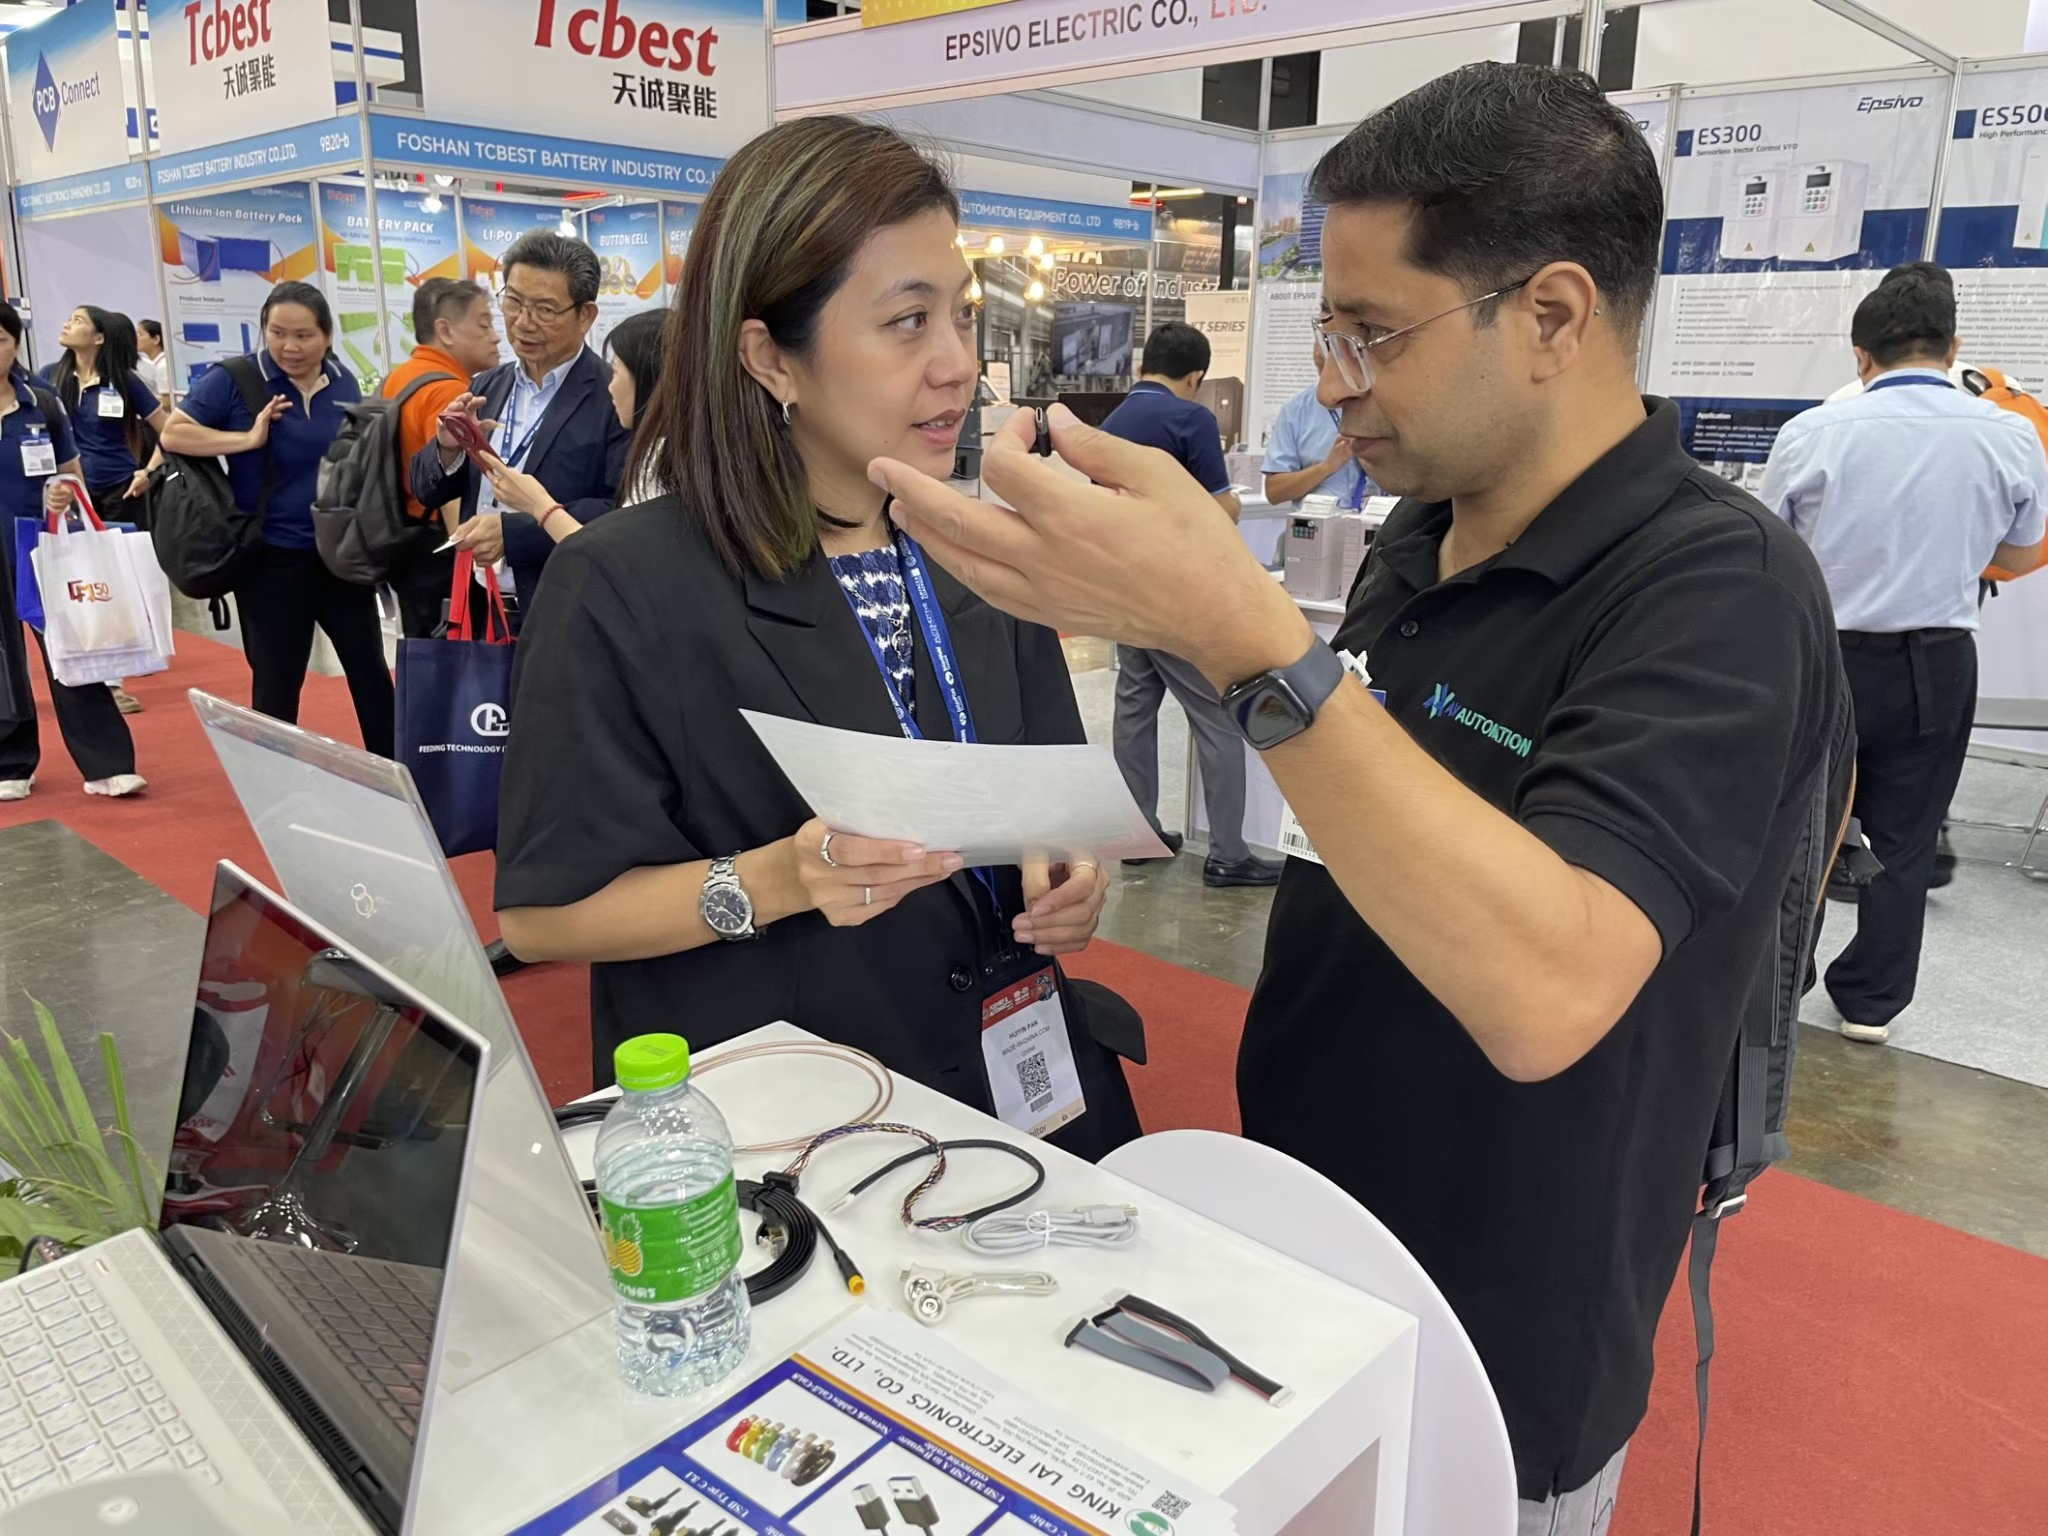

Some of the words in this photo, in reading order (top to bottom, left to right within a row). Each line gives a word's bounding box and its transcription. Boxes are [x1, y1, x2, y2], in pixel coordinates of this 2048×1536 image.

[184, 0, 272, 66] Tcbest
[945, 24, 1021, 61] EPSIVO
[1028, 5, 1142, 48] ELECTRIC
[1151, 0, 1198, 29] CO.,
[223, 53, 276, 100] 天诚聚能
[36, 86, 56, 115] PCB
[61, 71, 100, 105] Connect
[612, 72, 717, 119] 天诚聚能
[1698, 124, 1761, 145] ES300
[1979, 130, 1998, 139] High
[157, 168, 181, 184] FOSHAN
[182, 164, 204, 179] TCBEST
[205, 157, 234, 174] BATTERY
[233, 150, 267, 168] INDUSTRY
[397, 132, 471, 157] FOSHAN
[474, 142, 537, 165] TCBEST
[541, 150, 608, 173] BATTERY
[611, 159, 682, 181] INDUSTRY
[235, 208, 276, 225] Battery
[278, 212, 303, 225] Pack
[404, 220, 434, 234] PACK
[1018, 209, 1067, 224] EQUIPMENT
[1086, 215, 1101, 227] LTD
[600, 233, 630, 246] BUTTON
[631, 233, 648, 245] CELL
[1051, 267, 1121, 296] Power
[1123, 271, 1147, 297] of
[1207, 321, 1246, 332] SERIES
[419, 744, 446, 753] FEEDING
[447, 744, 501, 753] TECHNOLOGY
[828, 1346, 866, 1373] LTD.
[869, 1368, 906, 1396] CO.,
[906, 1392, 1025, 1464] ELECTRONICS
[698, 1480, 709, 1490] C
[1028, 1461, 1063, 1485] LAI
[707, 1486, 729, 1505] Type
[1066, 1482, 1121, 1519] KING
[728, 1499, 749, 1518] USB
[1027, 1512, 1059, 1533] Cable
